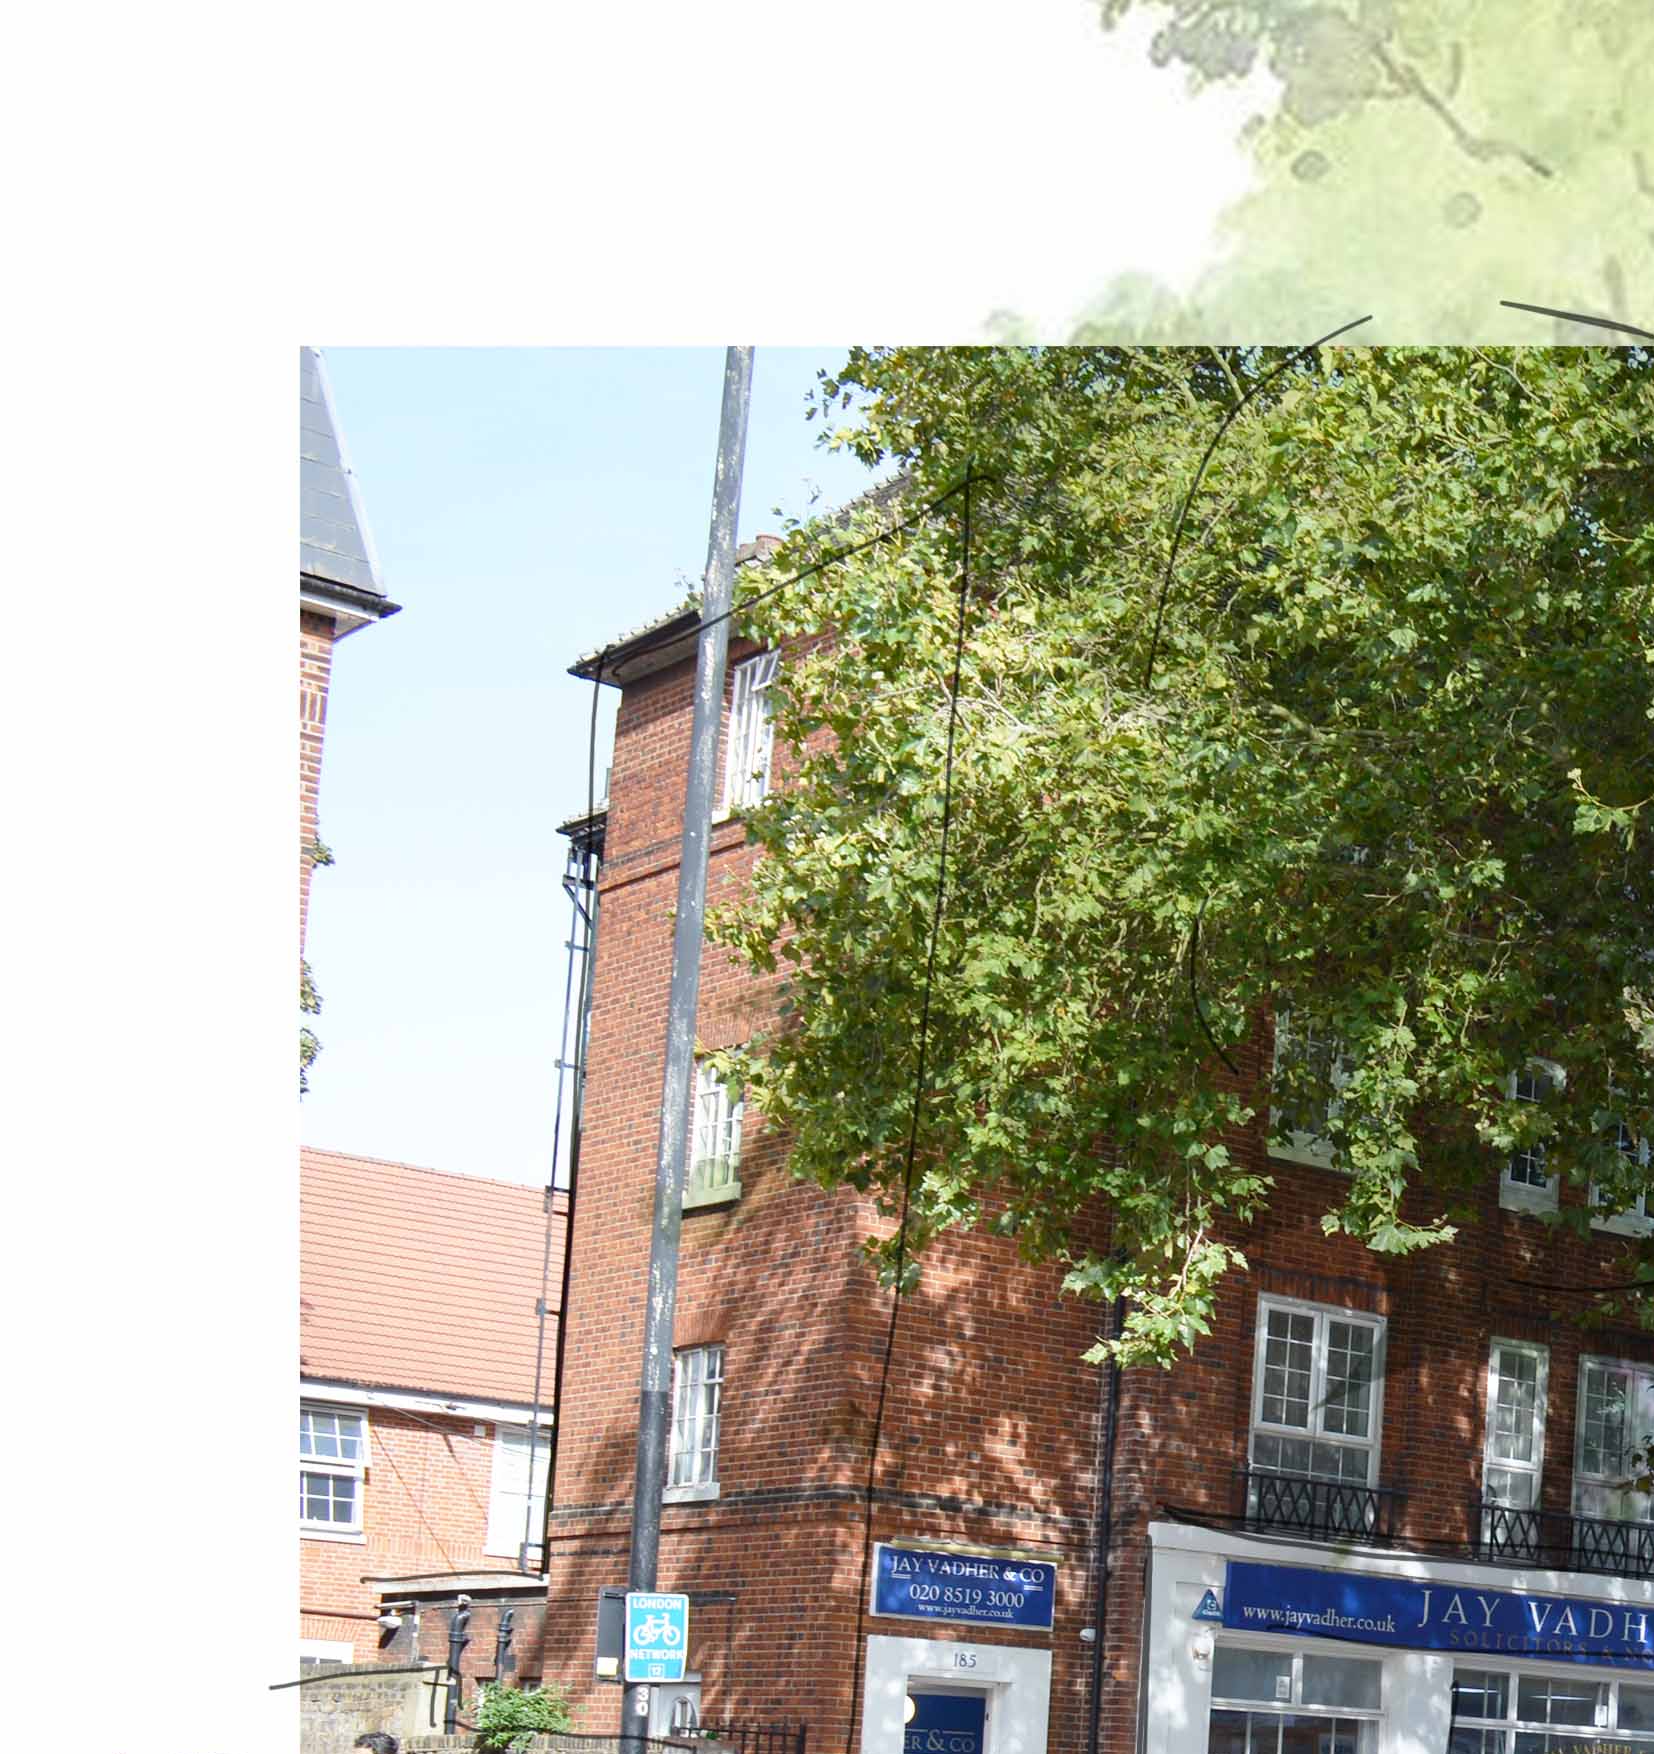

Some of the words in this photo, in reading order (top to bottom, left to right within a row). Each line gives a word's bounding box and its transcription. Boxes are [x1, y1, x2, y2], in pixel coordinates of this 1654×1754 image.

[891, 1556, 923, 1573] JAY
[928, 1558, 999, 1579] VADHER
[1003, 1567, 1017, 1581] &
[1020, 1568, 1044, 1583] CO
[633, 1598, 680, 1609] LONDON
[909, 1584, 940, 1600] 020
[944, 1588, 982, 1604] 8519
[987, 1590, 1024, 1608] 3000
[918, 1603, 1014, 1618] www.jayvadher.co.uk
[1243, 1605, 1395, 1632] www.jayvadher.co.uk
[1418, 1590, 1500, 1627] JAY
[628, 1649, 684, 1660] NETWORK
[954, 1653, 976, 1668] 185
[928, 1729, 945, 1751] &
[950, 1737, 975, 1752] CO
